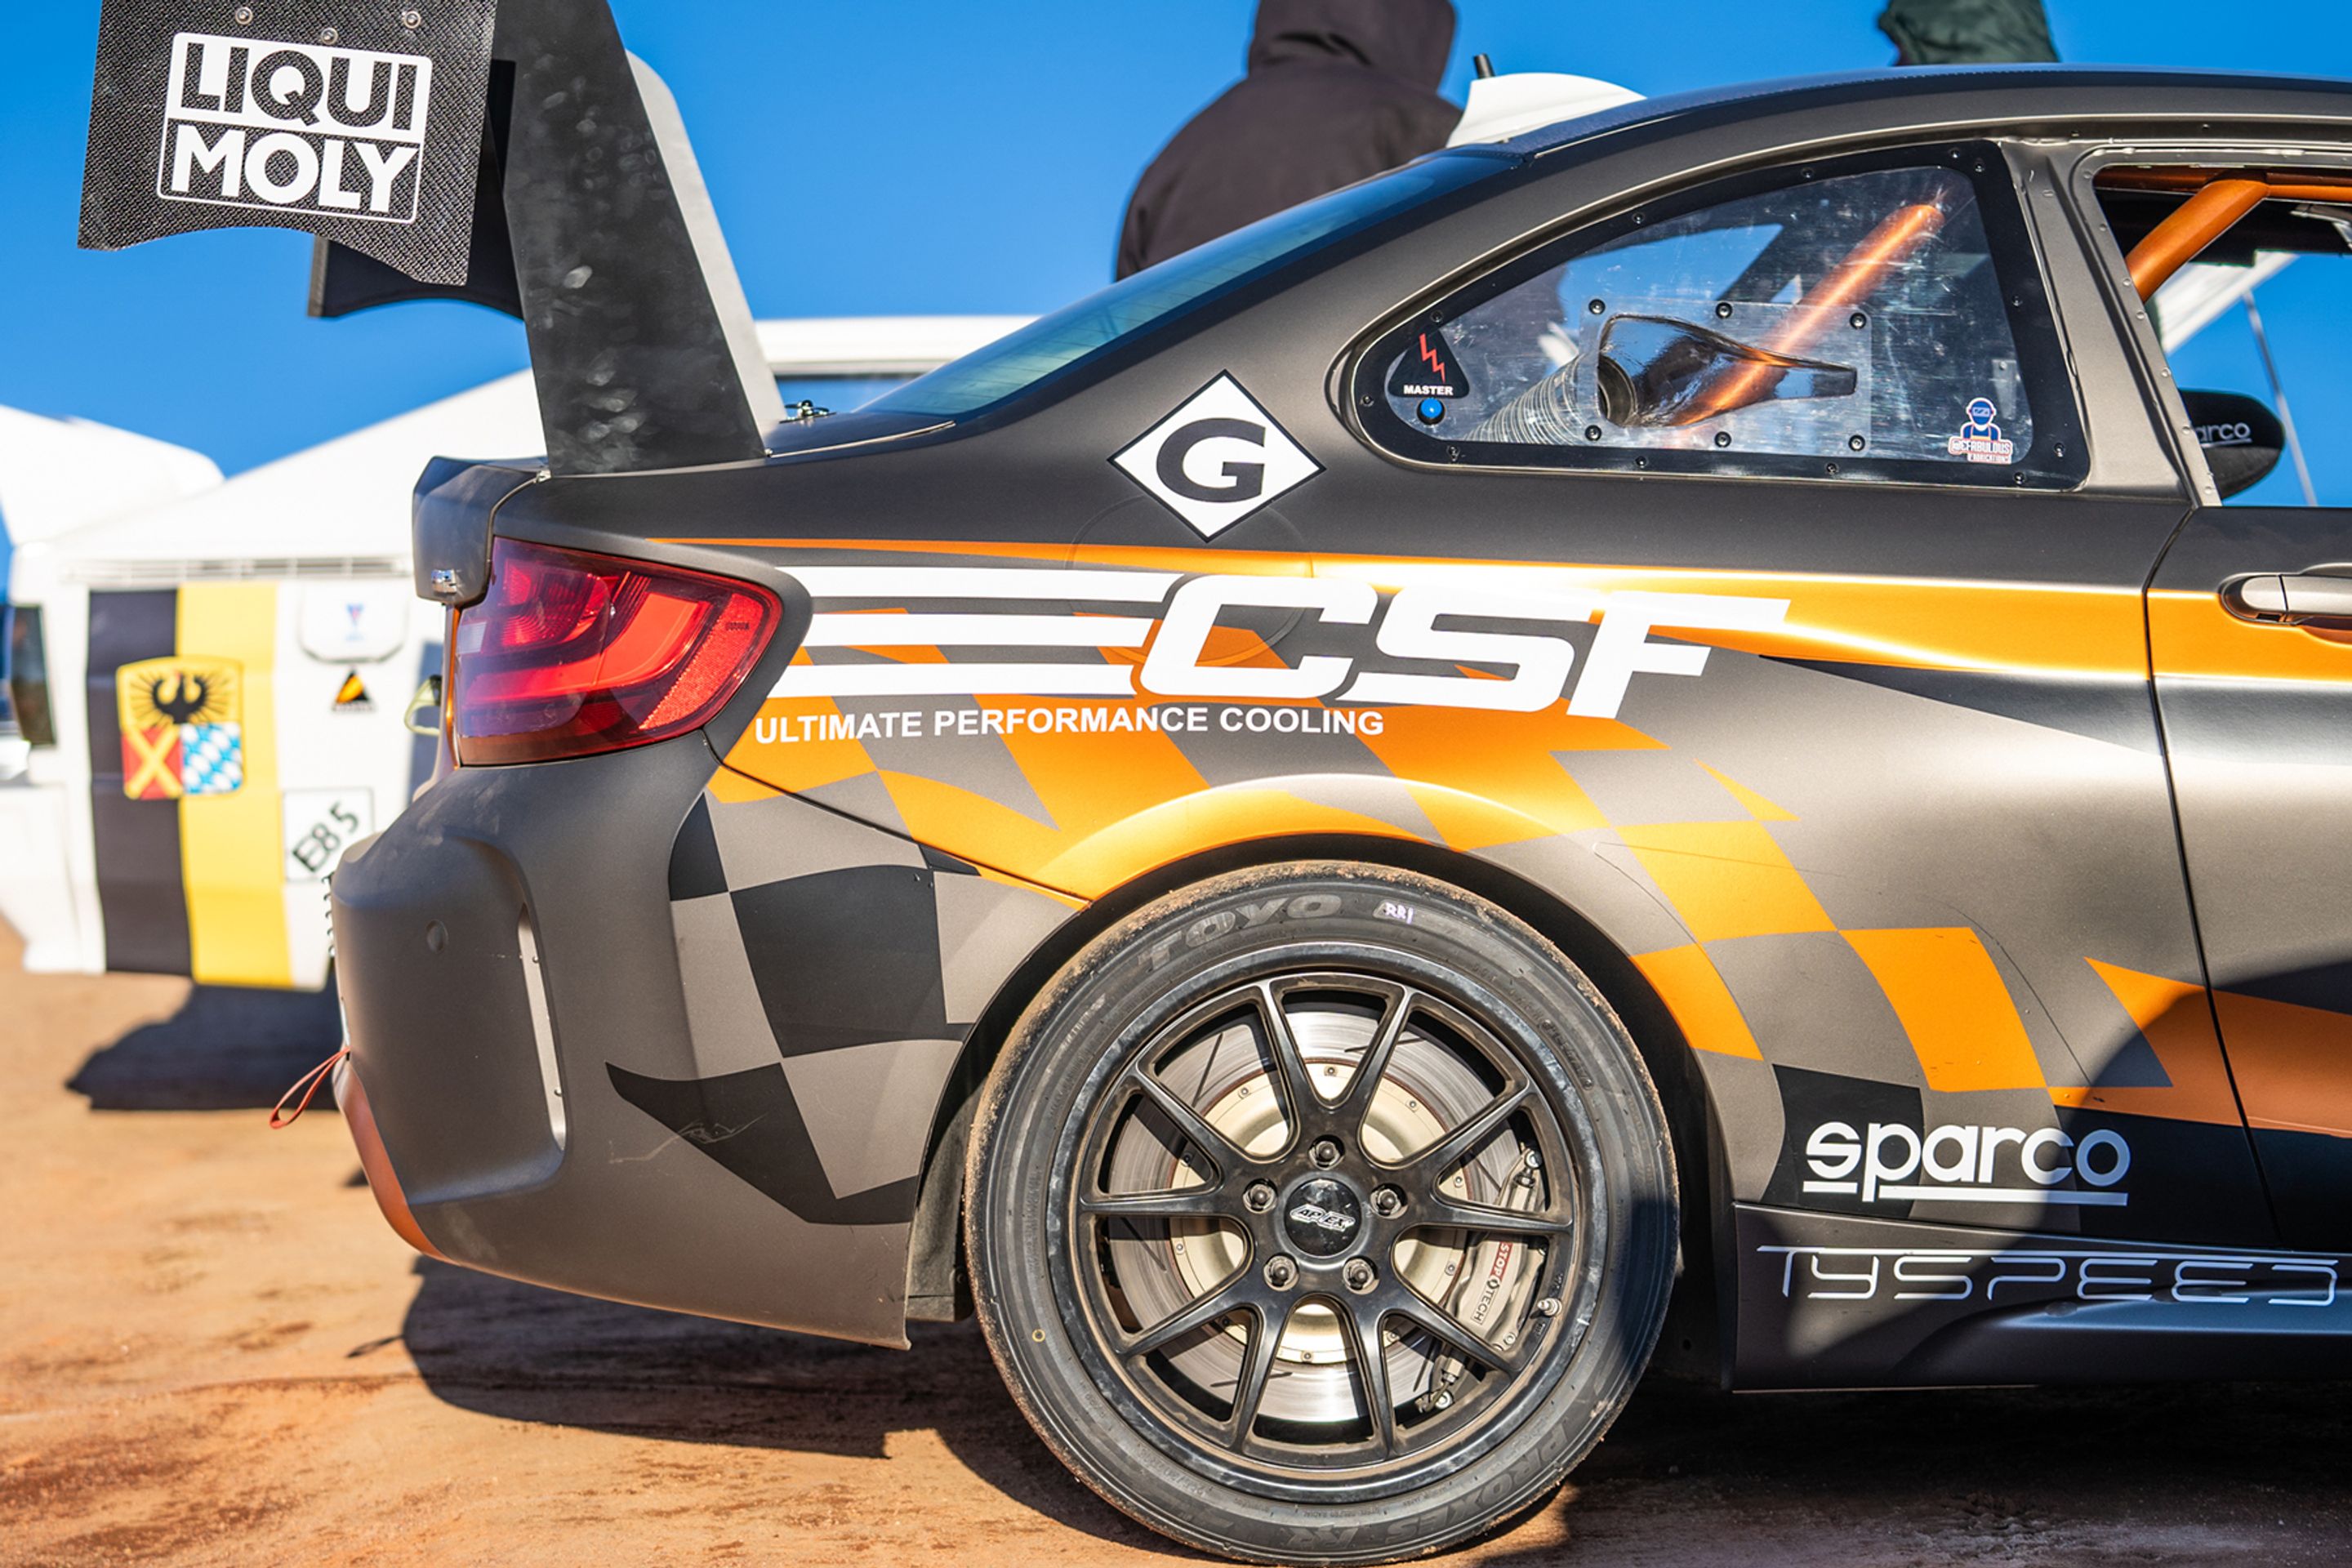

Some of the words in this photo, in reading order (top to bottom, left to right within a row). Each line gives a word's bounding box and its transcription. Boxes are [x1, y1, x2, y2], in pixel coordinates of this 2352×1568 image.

[180, 42, 418, 131] LIQUI
[172, 124, 420, 212] MOLY
[1403, 384, 1453, 396] MASTER
[1156, 417, 1266, 503] G
[2195, 422, 2251, 443] arco
[1140, 572, 1790, 719] CSF
[755, 711, 923, 744] ULTIMATE
[933, 707, 1209, 737] PERFORMANCE
[1219, 707, 1384, 737] COOLING
[292, 800, 359, 872] E85
[1138, 894, 1342, 971] TOYO
[1802, 1121, 2131, 1206] sparco
[1290, 1204, 1356, 1232] APEX
[1491, 1243, 1512, 1281] STOP
[1473, 1288, 1496, 1322] TECH
[1387, 1423, 1568, 1540] PROXES
